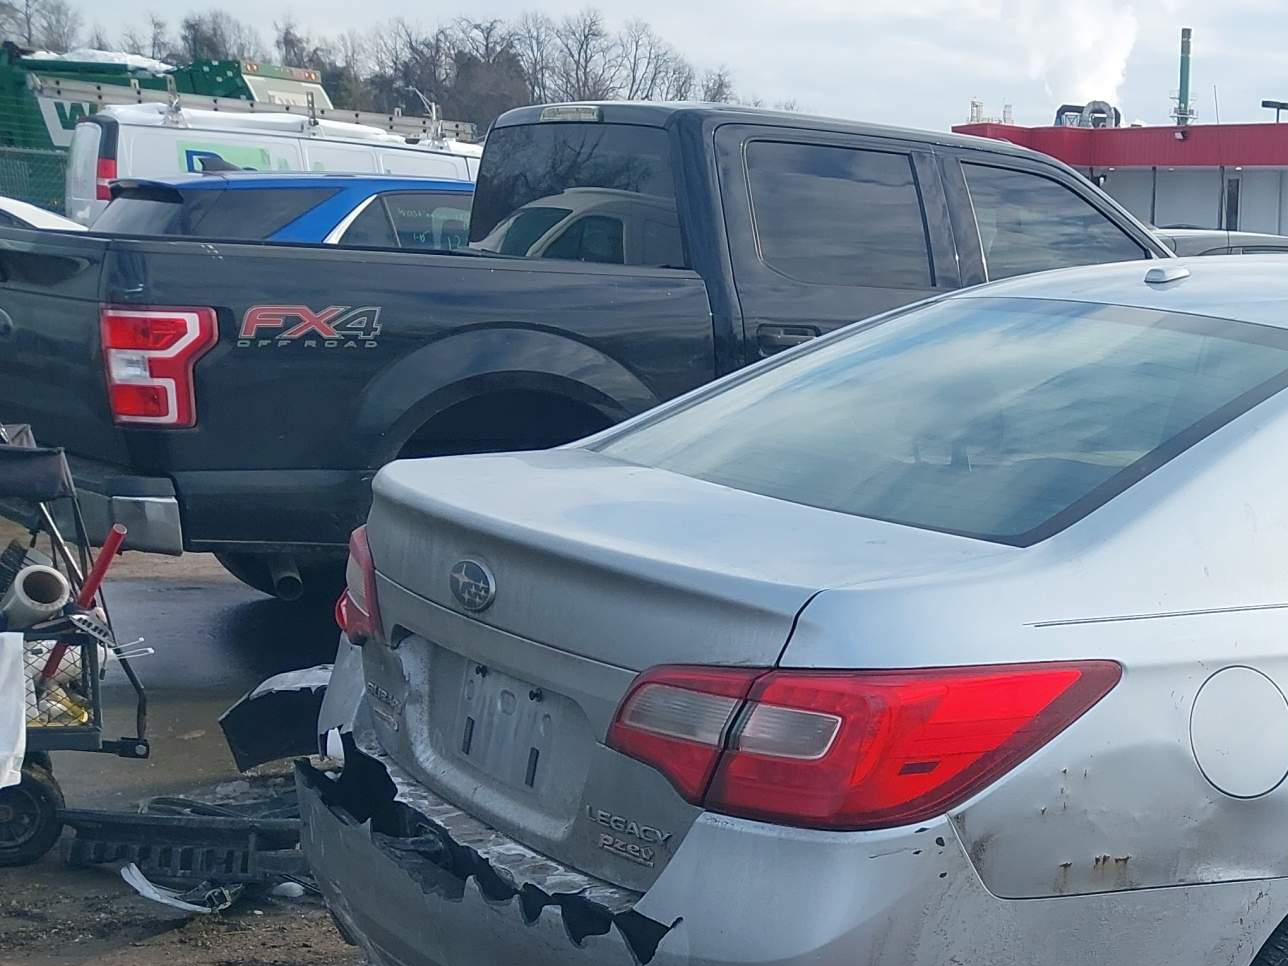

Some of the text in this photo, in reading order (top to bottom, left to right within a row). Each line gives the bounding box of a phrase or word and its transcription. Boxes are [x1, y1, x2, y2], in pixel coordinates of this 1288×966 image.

[239, 304, 382, 340] FX4
[236, 339, 378, 349] OFF ROAD
[585, 804, 672, 845] LEGACY
[600, 833, 655, 861] pzev
